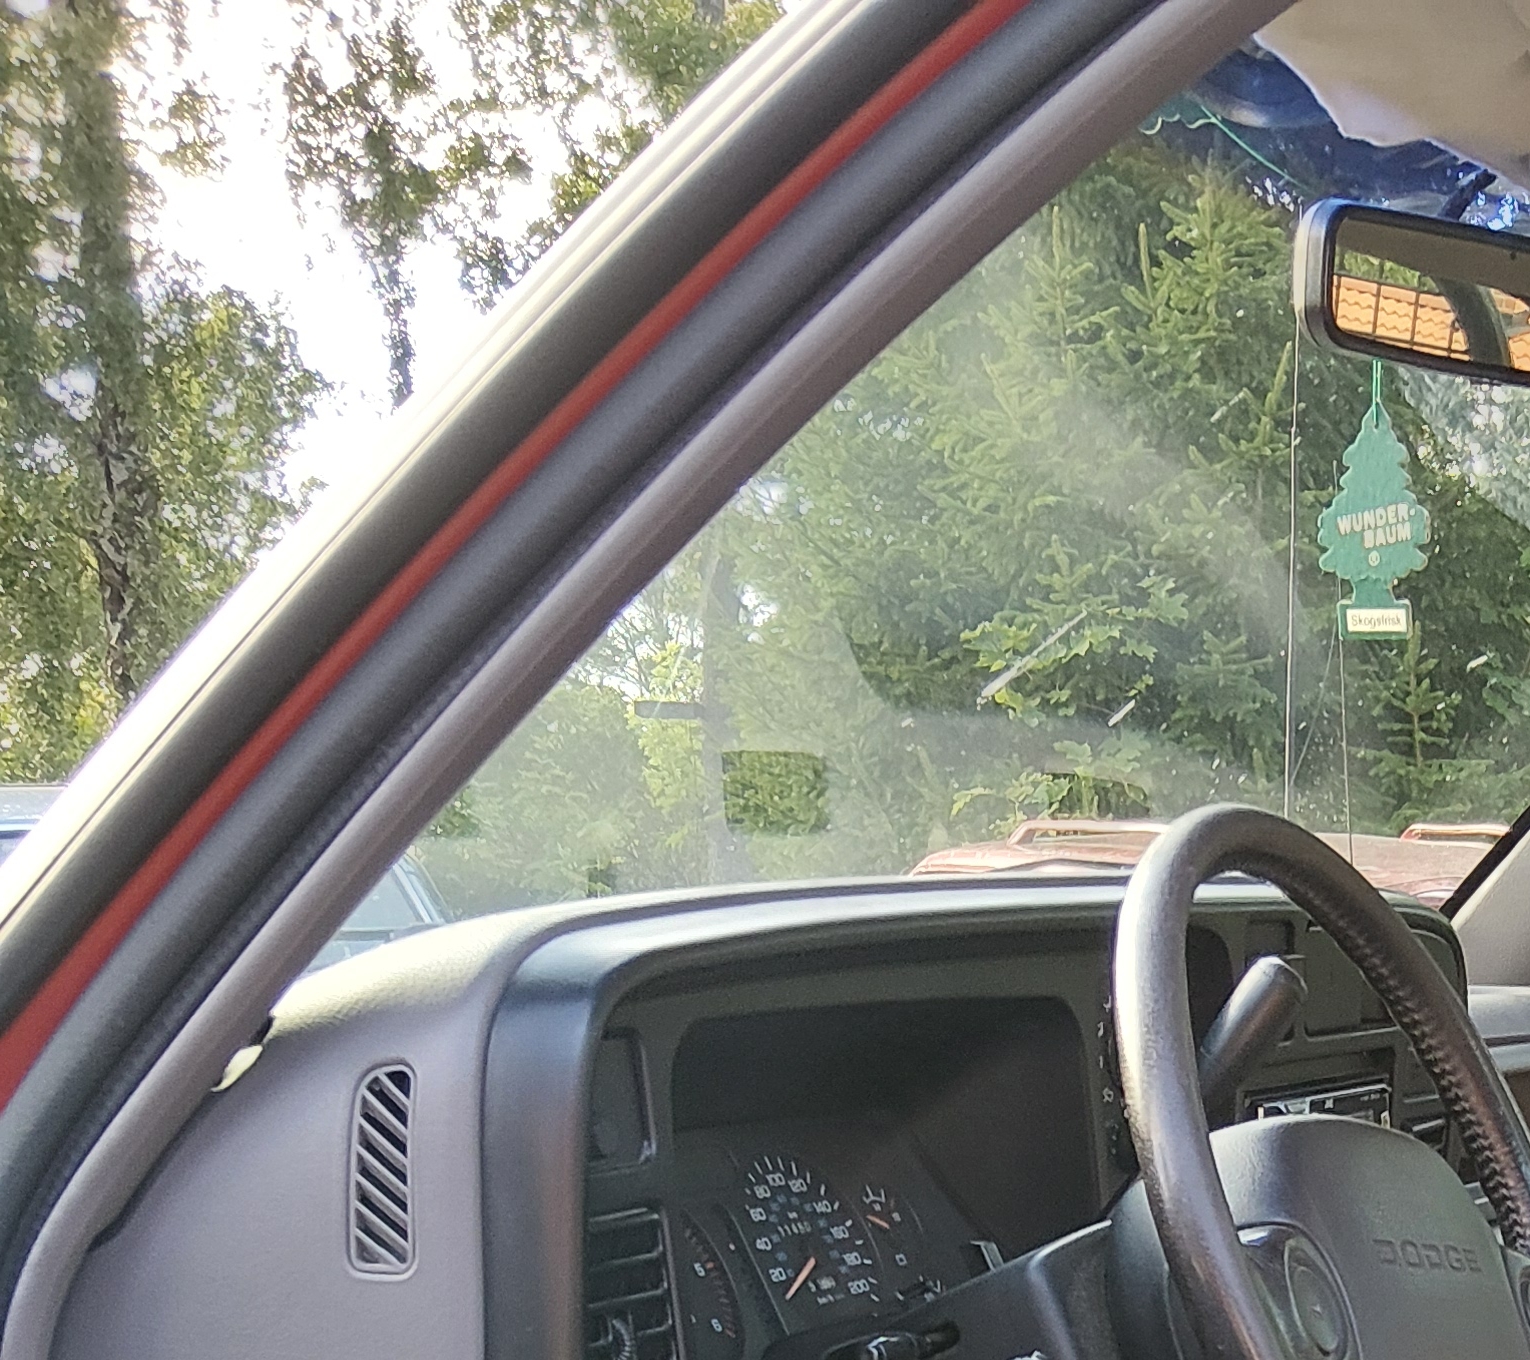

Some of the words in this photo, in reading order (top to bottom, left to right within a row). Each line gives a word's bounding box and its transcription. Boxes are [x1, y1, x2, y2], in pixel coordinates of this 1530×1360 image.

[1363, 522, 1412, 548] BAUM
[1371, 1238, 1483, 1273] DODGE
[769, 1267, 787, 1282] 20
[848, 1278, 870, 1295] 200
